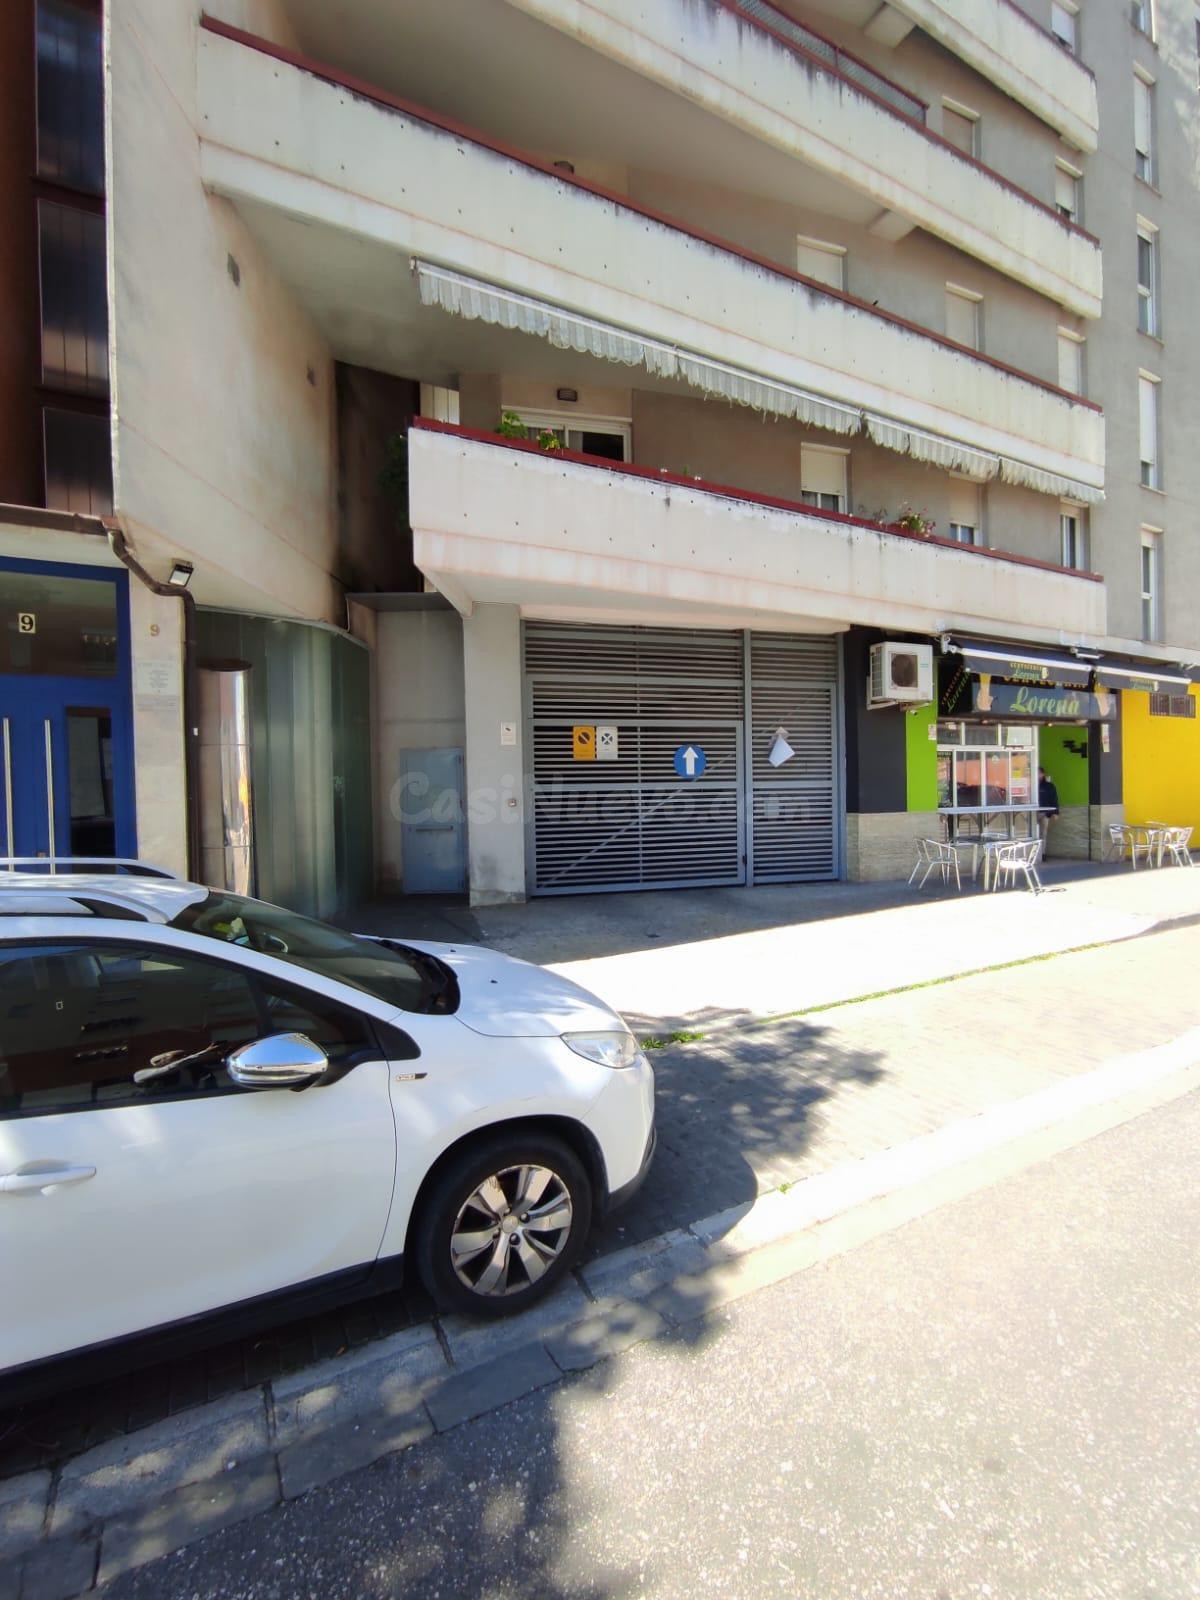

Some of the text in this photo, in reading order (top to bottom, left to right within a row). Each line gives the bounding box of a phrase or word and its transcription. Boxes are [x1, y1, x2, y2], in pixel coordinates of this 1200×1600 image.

[21, 614, 33, 631] 9
[150, 624, 160, 637] 9
[1009, 686, 1081, 716] Lorena
